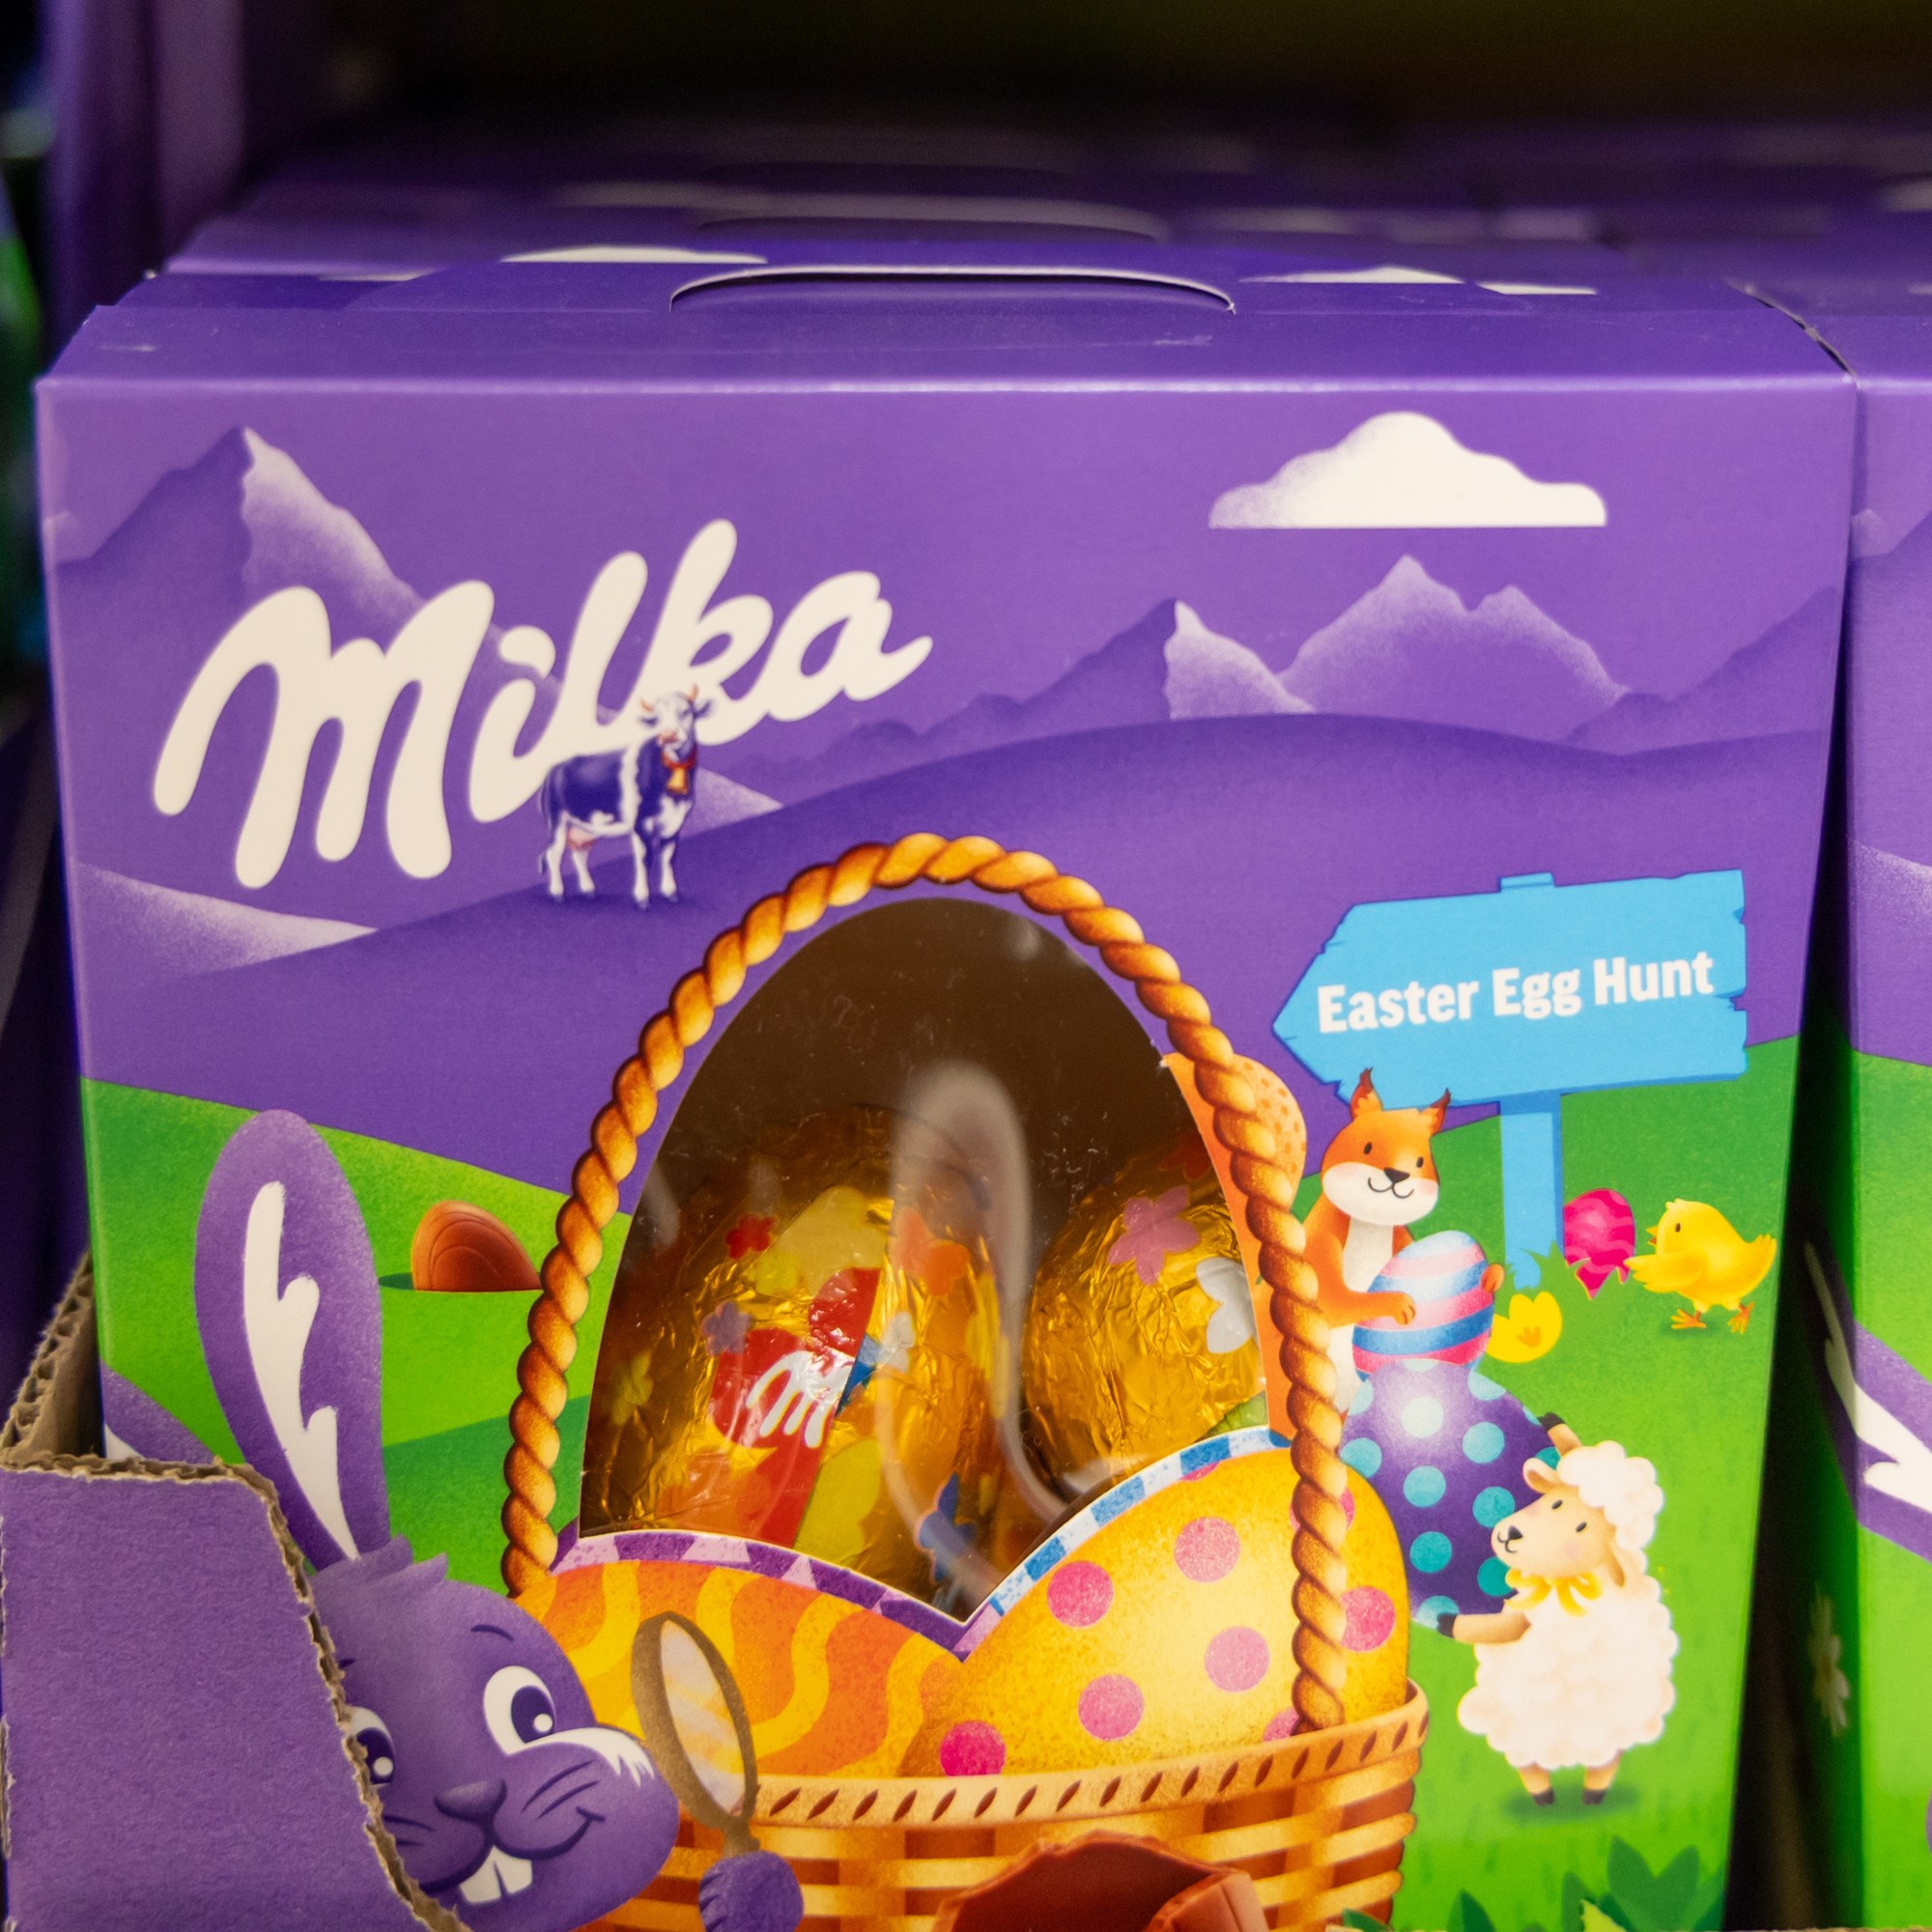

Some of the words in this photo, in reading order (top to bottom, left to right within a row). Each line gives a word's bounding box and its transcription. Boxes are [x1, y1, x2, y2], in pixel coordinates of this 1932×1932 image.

[153, 518, 933, 889] Milka
[1317, 980, 1480, 1035] Easter
[1492, 967, 1583, 1021] Egg
[1593, 951, 1715, 1007] Hunt
